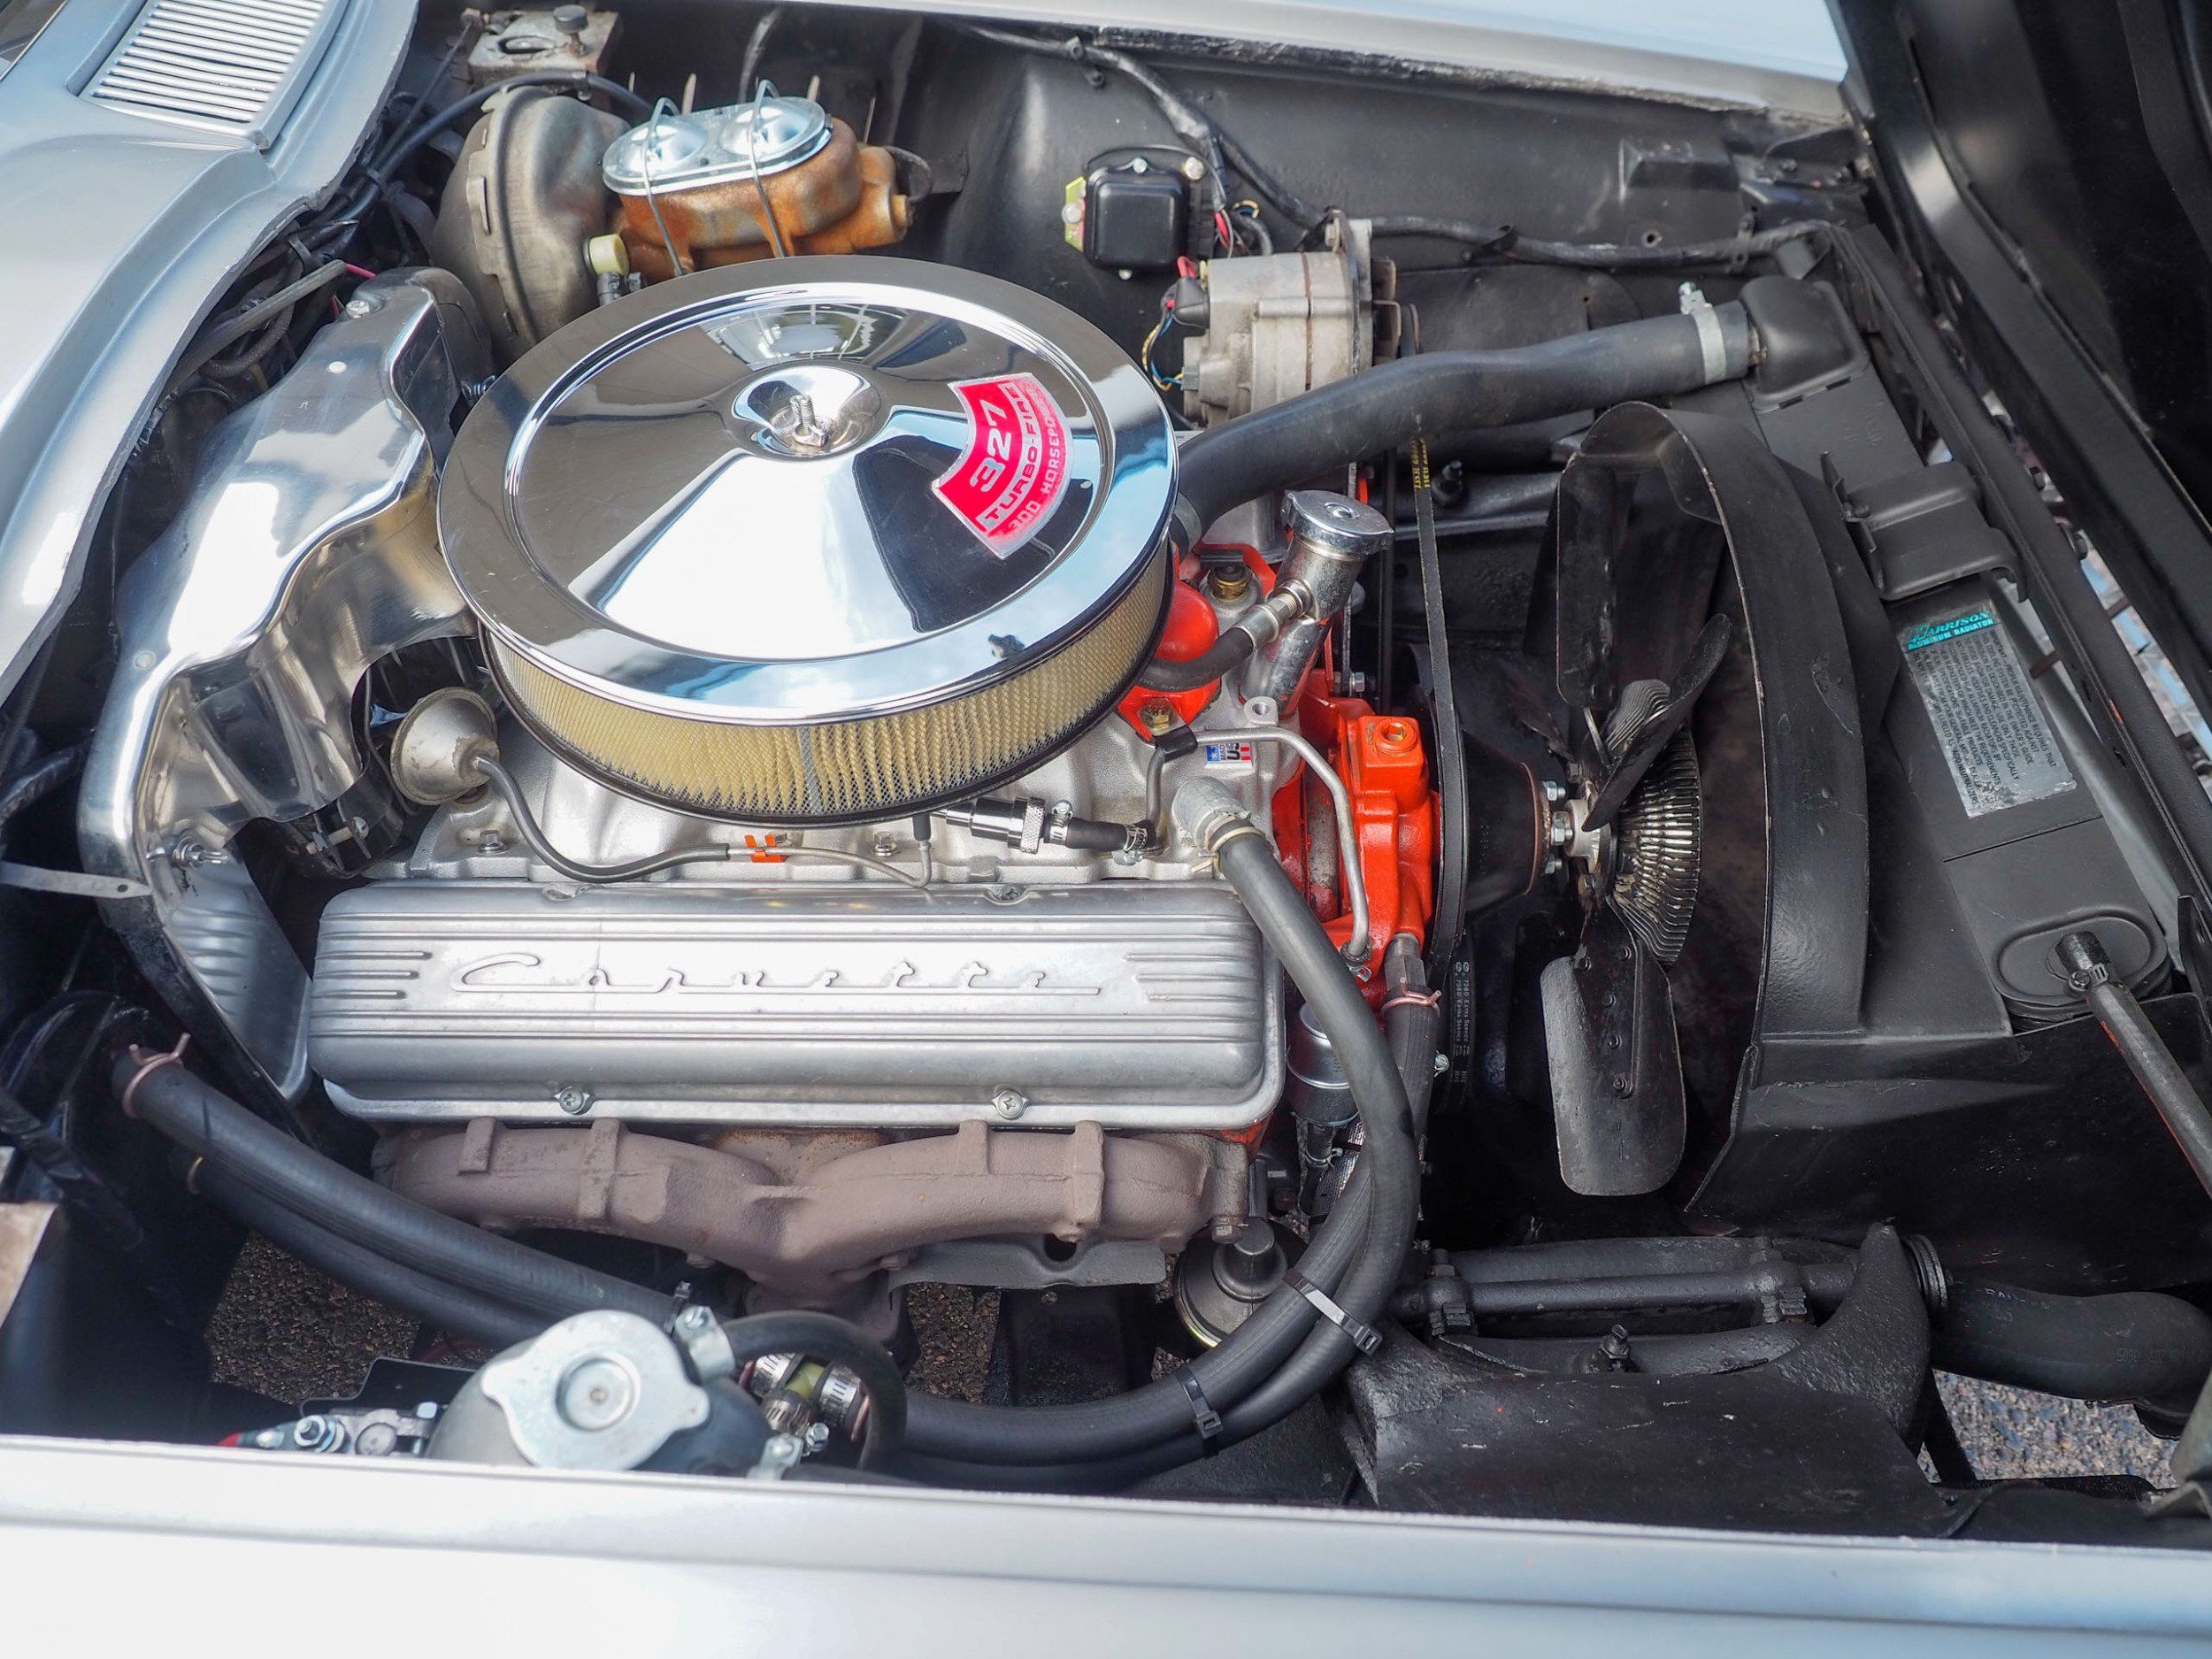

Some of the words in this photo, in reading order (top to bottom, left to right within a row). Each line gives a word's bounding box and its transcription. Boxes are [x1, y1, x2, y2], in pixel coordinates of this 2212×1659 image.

[970, 399, 1012, 493] 327
[984, 385, 1040, 520] TURBO-FIRE
[1953, 618, 1994, 636] RADIATOR
[1226, 743, 1240, 760] US
[451, 951, 1102, 995] Corvette
